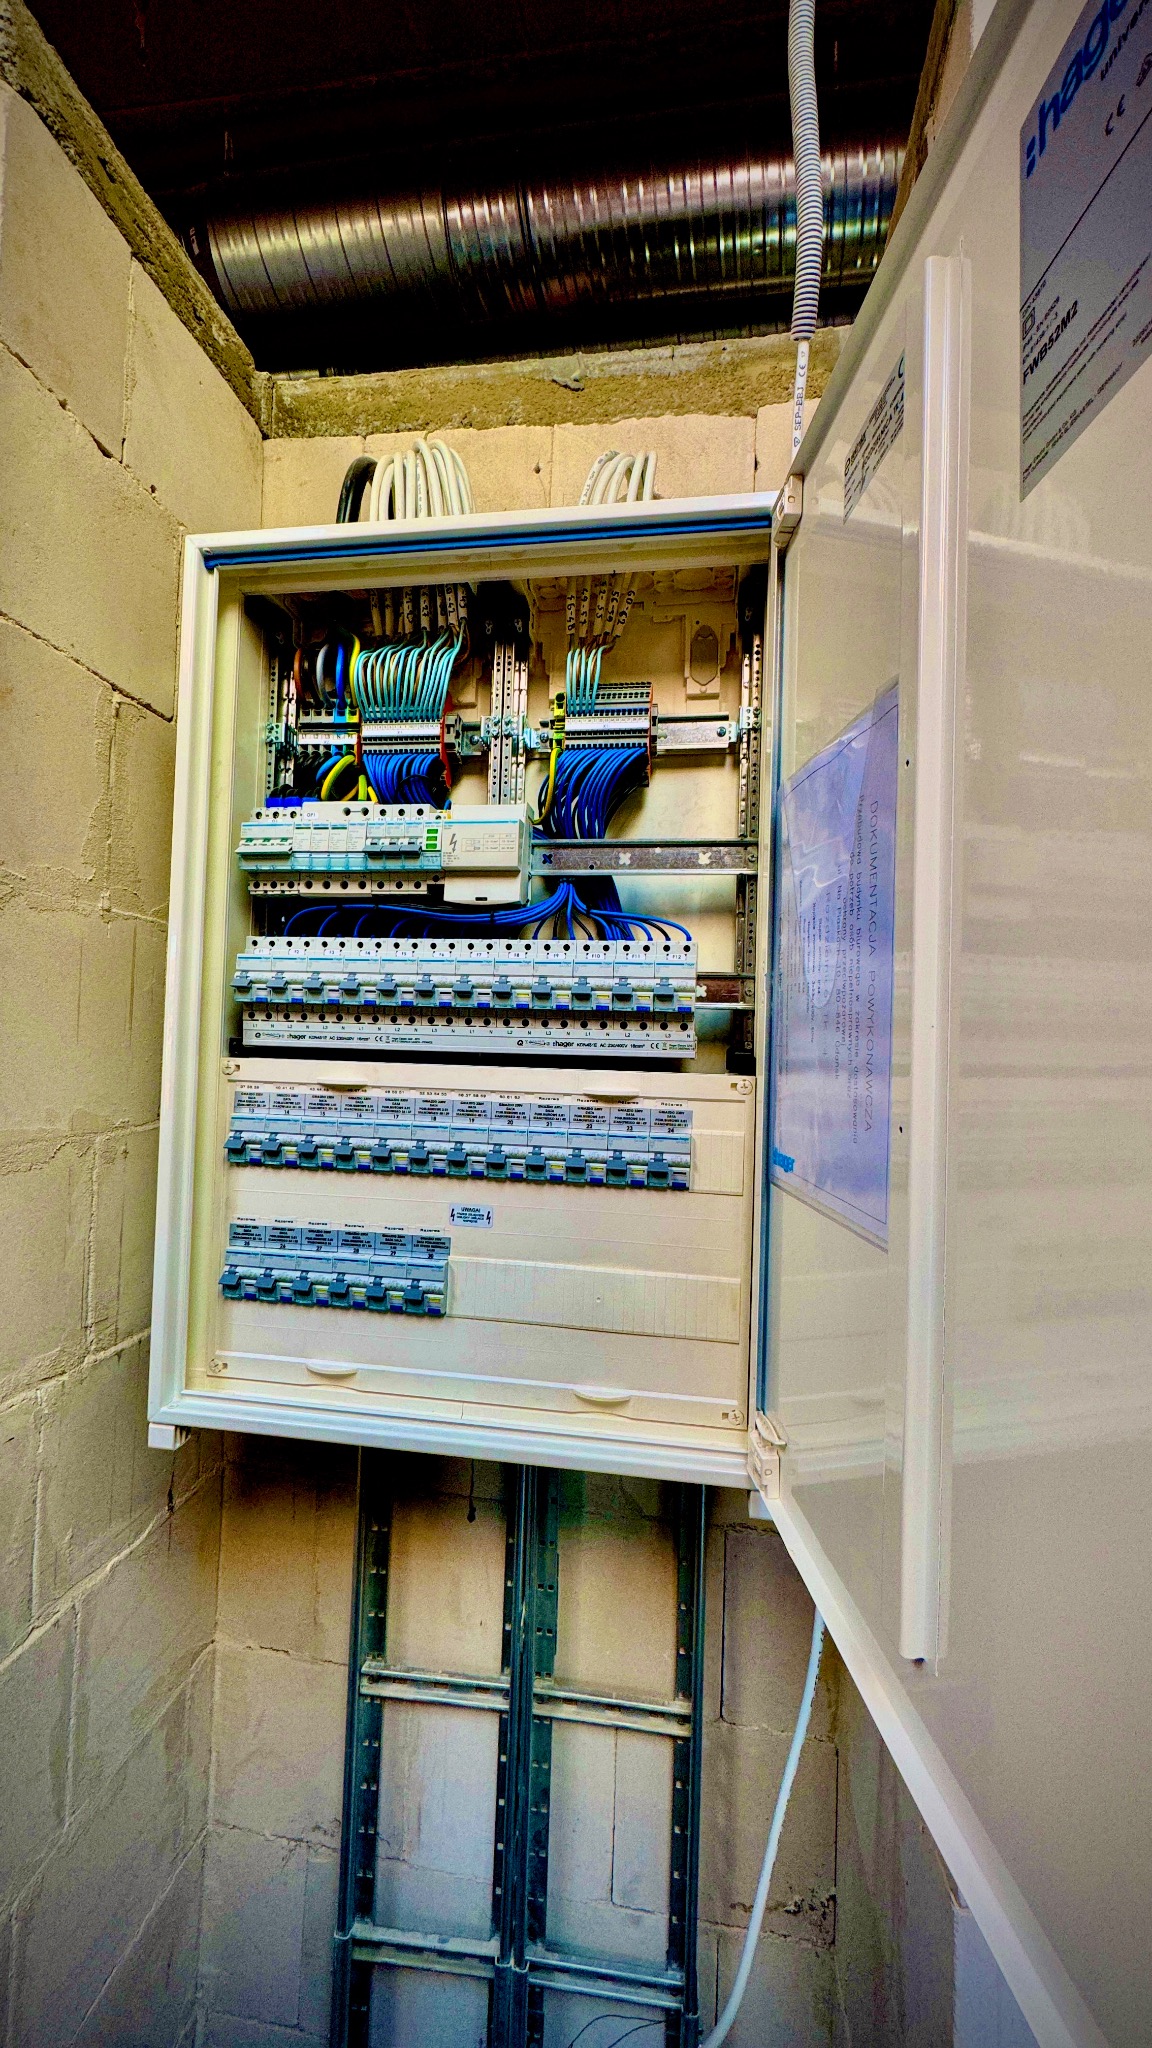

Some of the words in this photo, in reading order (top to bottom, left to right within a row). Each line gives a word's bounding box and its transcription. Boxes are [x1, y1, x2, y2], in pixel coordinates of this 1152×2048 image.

[1023, 300, 1078, 386] FWB52M2
[868, 800, 878, 956] DOKUMENTACJA
[863, 970, 875, 1133] POWYKONAWCZA
